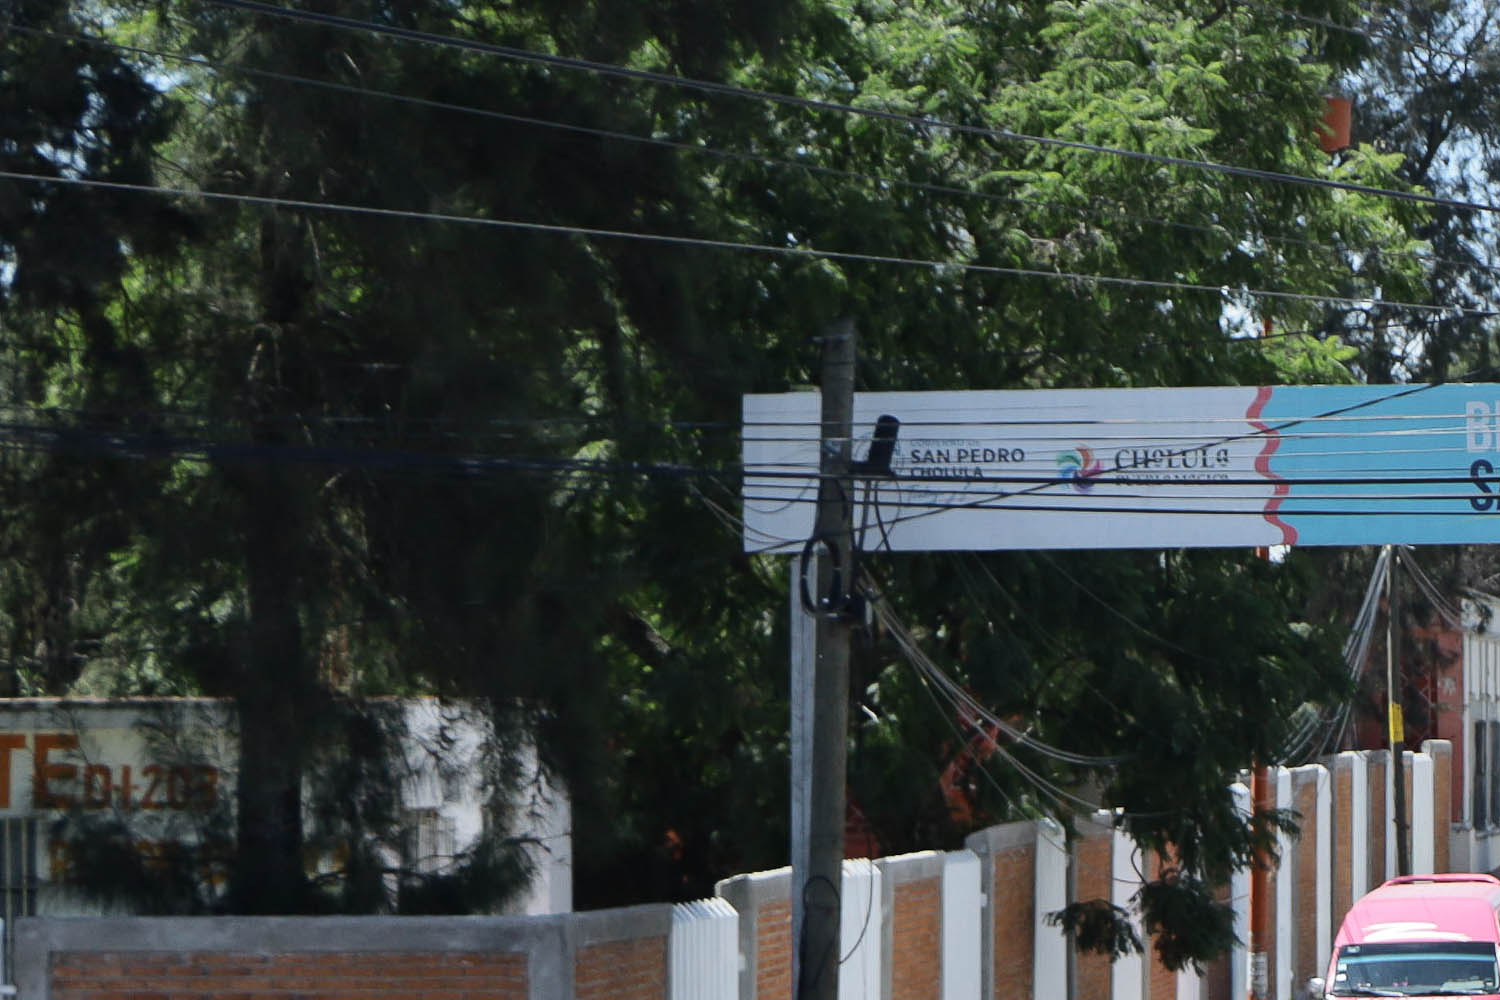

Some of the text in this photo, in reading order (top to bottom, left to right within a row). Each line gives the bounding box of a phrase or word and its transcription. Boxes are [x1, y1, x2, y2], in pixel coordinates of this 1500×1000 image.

[910, 448, 1025, 464] SAN PEDRO
[910, 466, 984, 479] CHOLULA
